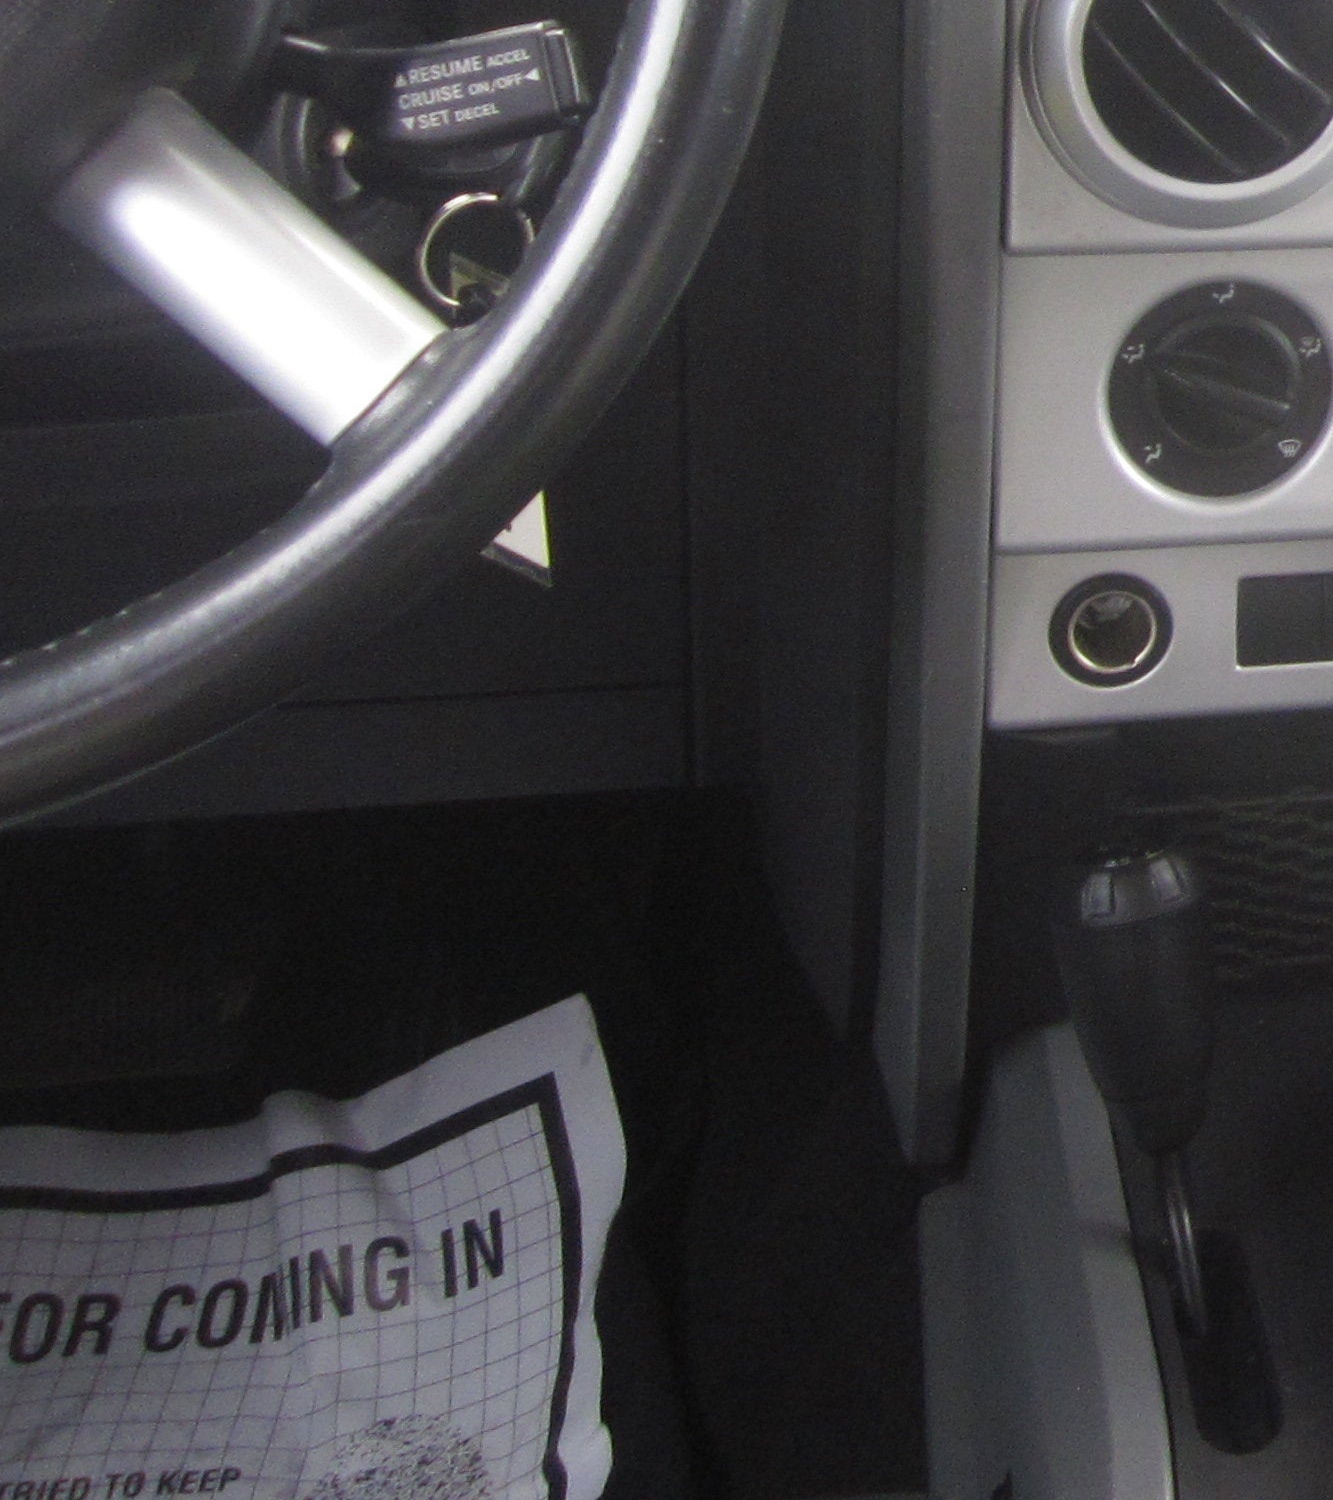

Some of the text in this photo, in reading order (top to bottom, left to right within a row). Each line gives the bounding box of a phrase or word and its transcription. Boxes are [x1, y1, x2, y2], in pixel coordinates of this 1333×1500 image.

[408, 49, 531, 84] RESUME ACCEL
[399, 72, 523, 110] CRUISE ON/OFF
[418, 102, 500, 129] SET DECEL
[441, 1208, 504, 1299] IN
[105, 1470, 145, 1499] TO
[156, 1466, 242, 1496] KEEP
